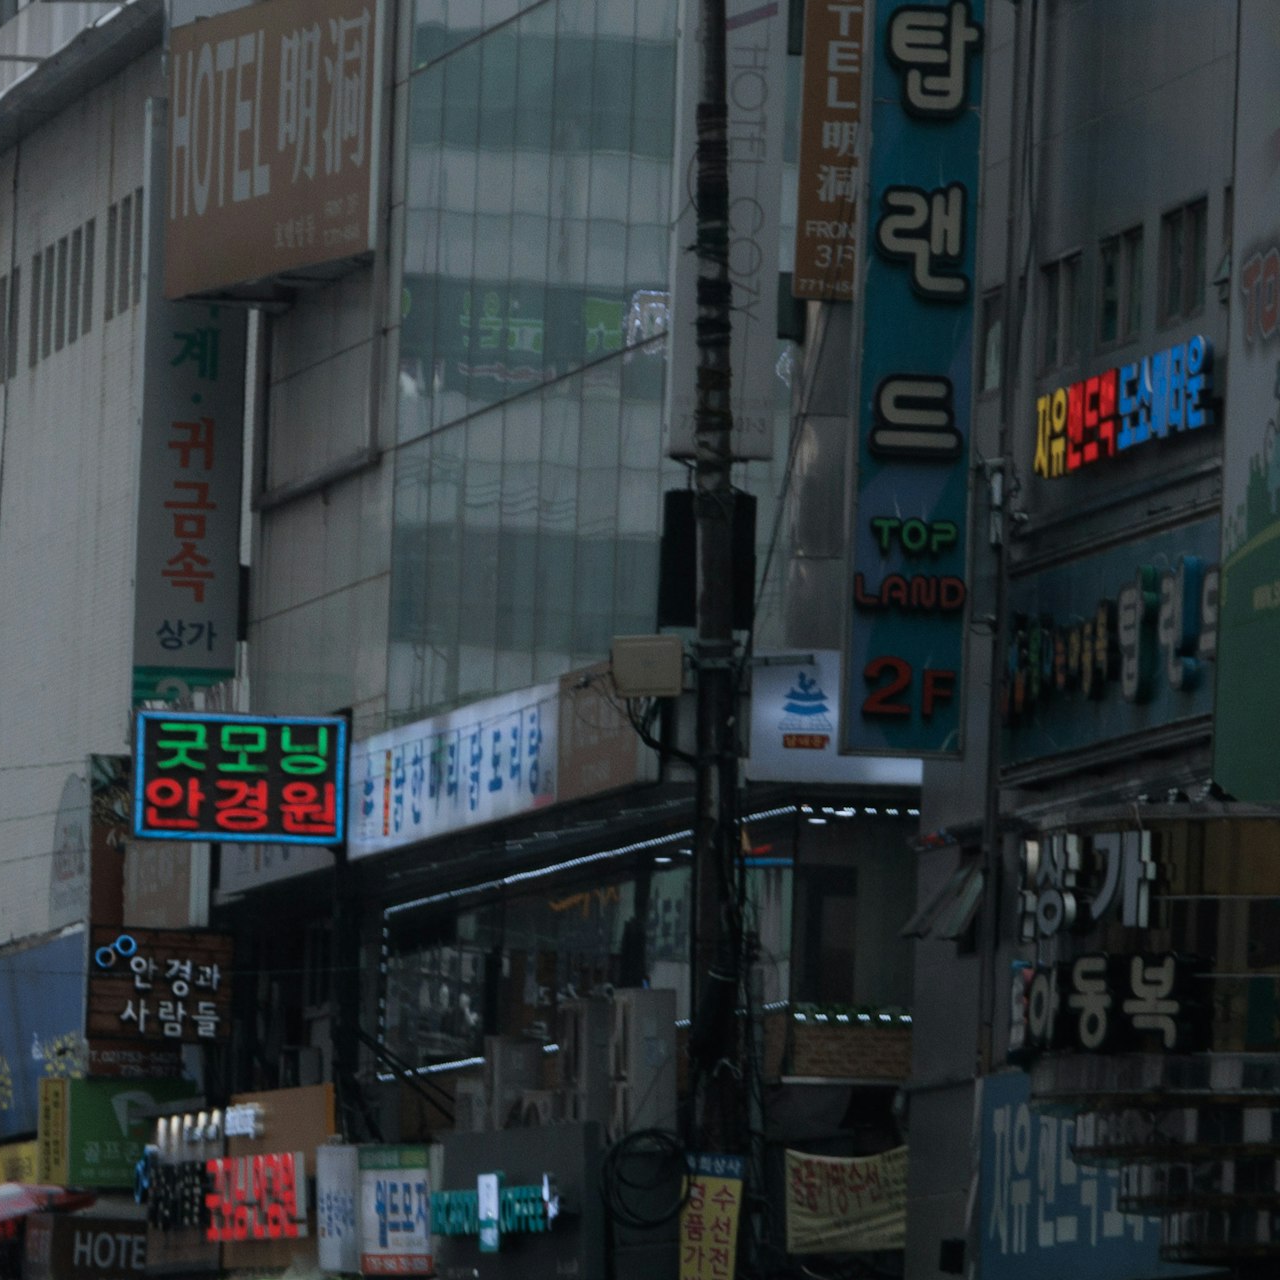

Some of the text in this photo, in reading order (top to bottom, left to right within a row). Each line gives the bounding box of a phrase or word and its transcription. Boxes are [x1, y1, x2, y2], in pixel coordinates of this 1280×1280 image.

[171, 30, 269, 220] HOTEL
[867, 2, 980, 461] 탑랜드
[871, 516, 957, 553] TOP
[854, 574, 966, 613] LAND
[156, 619, 217, 652] 상가
[862, 657, 957, 718] 2F
[157, 722, 329, 776] 굿모닝
[145, 776, 337, 836] 안경원
[1036, 829, 1154, 936] 상가
[129, 954, 221, 998] 안경과
[1029, 954, 1180, 1050] 아동복
[120, 1000, 221, 1039] 사람들
